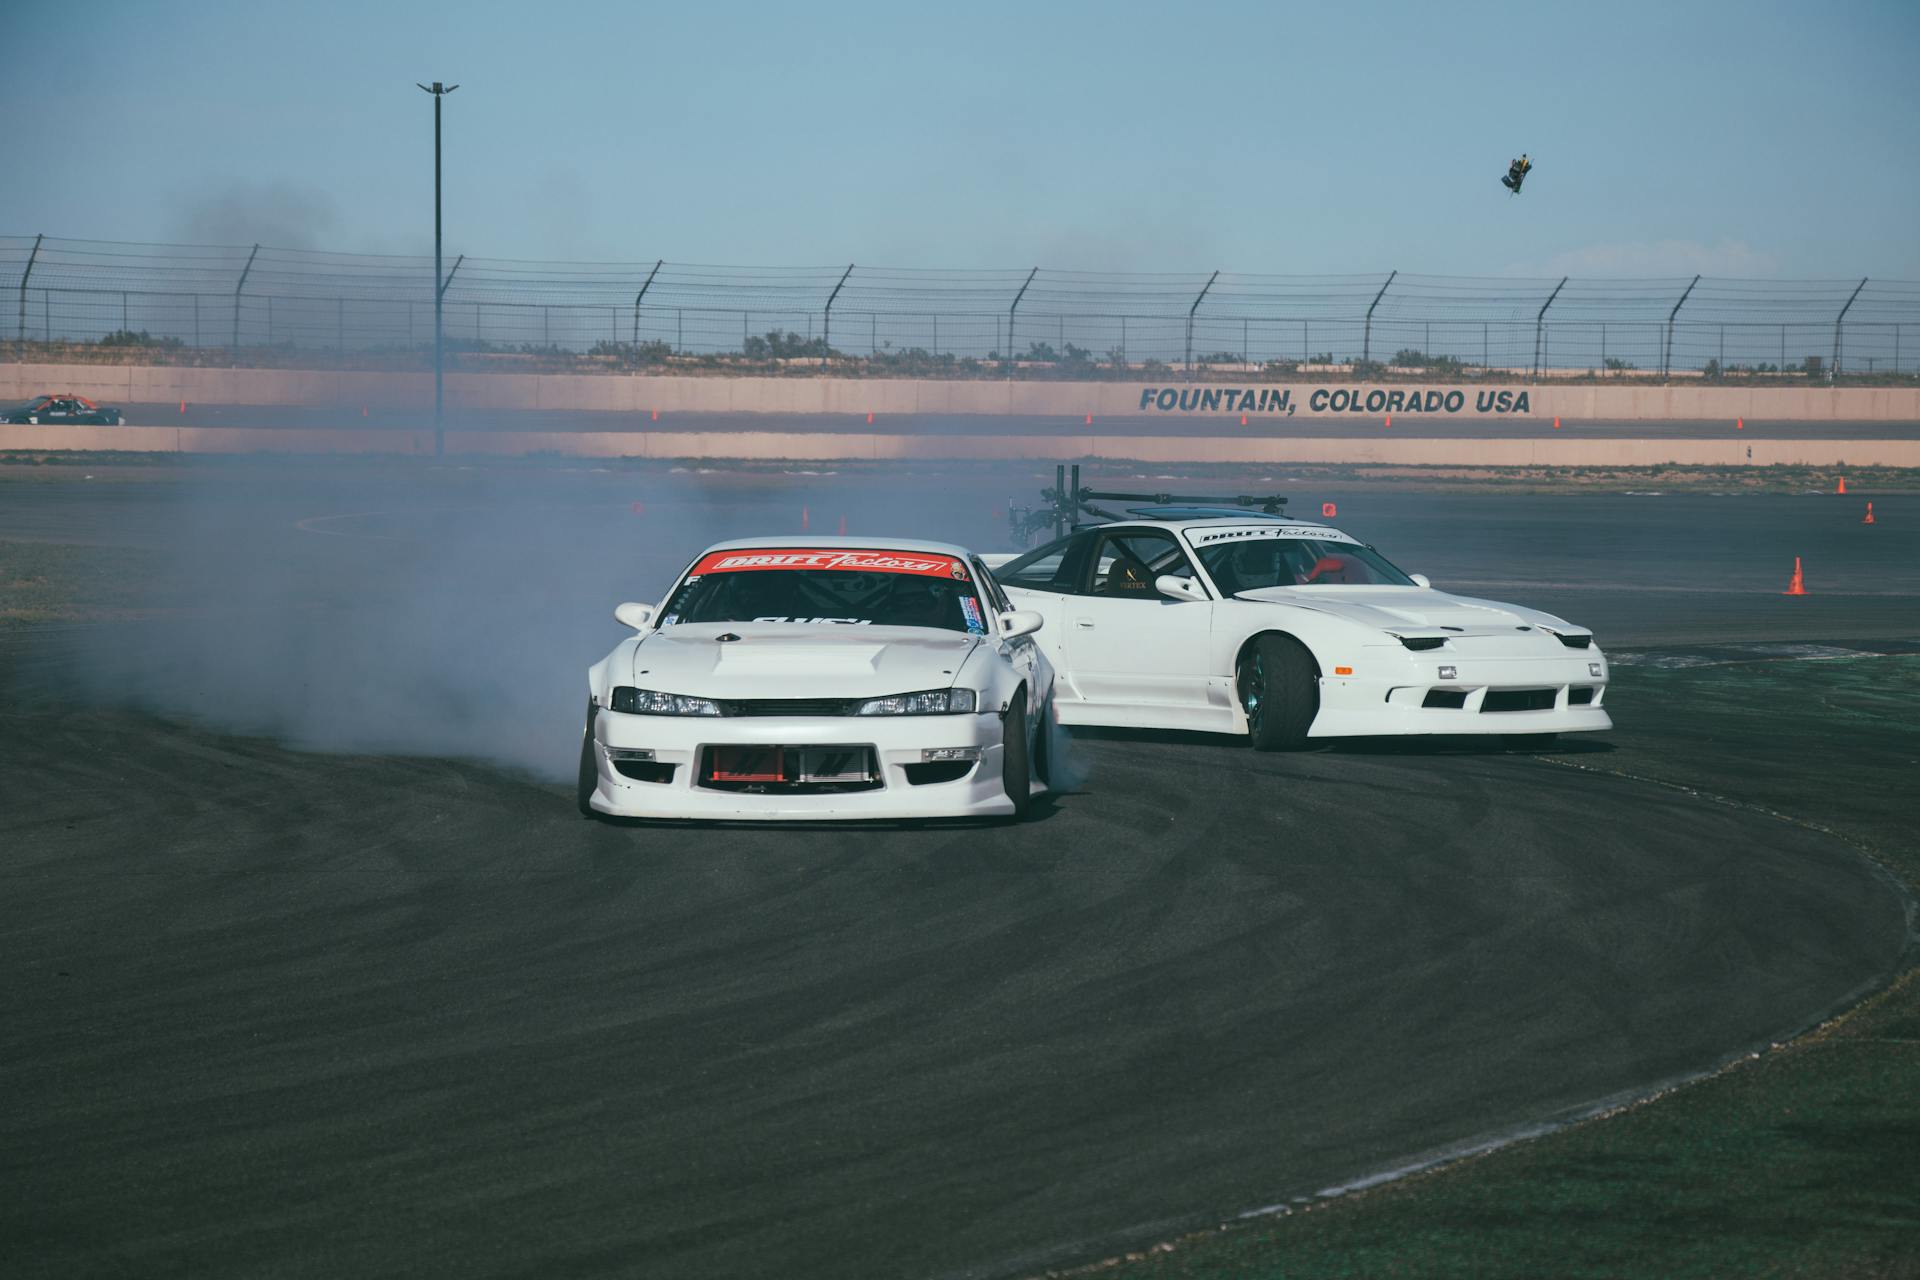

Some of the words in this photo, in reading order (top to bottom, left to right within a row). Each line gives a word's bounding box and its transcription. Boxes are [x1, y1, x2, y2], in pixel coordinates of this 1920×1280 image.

[1139, 388, 1296, 417] FOUNTAIN,
[1309, 388, 1465, 412] COLORADO
[1475, 391, 1530, 413] USA
[718, 555, 834, 568] DRIFT
[824, 552, 936, 571] Factory
